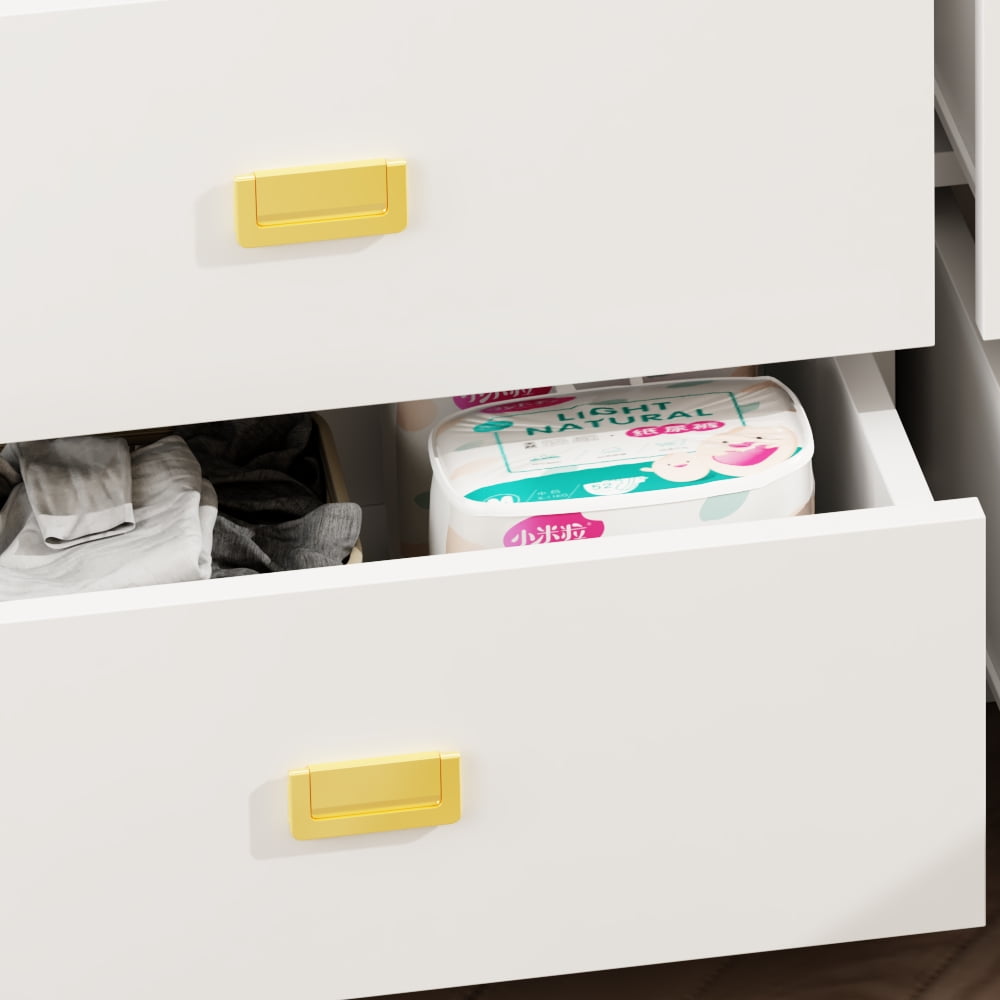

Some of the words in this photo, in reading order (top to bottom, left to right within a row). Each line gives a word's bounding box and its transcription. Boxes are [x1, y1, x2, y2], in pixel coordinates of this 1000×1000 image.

[526, 409, 713, 436] NATURAL
[557, 402, 671, 421] LIGHT
[511, 522, 588, 546] 小米粒
